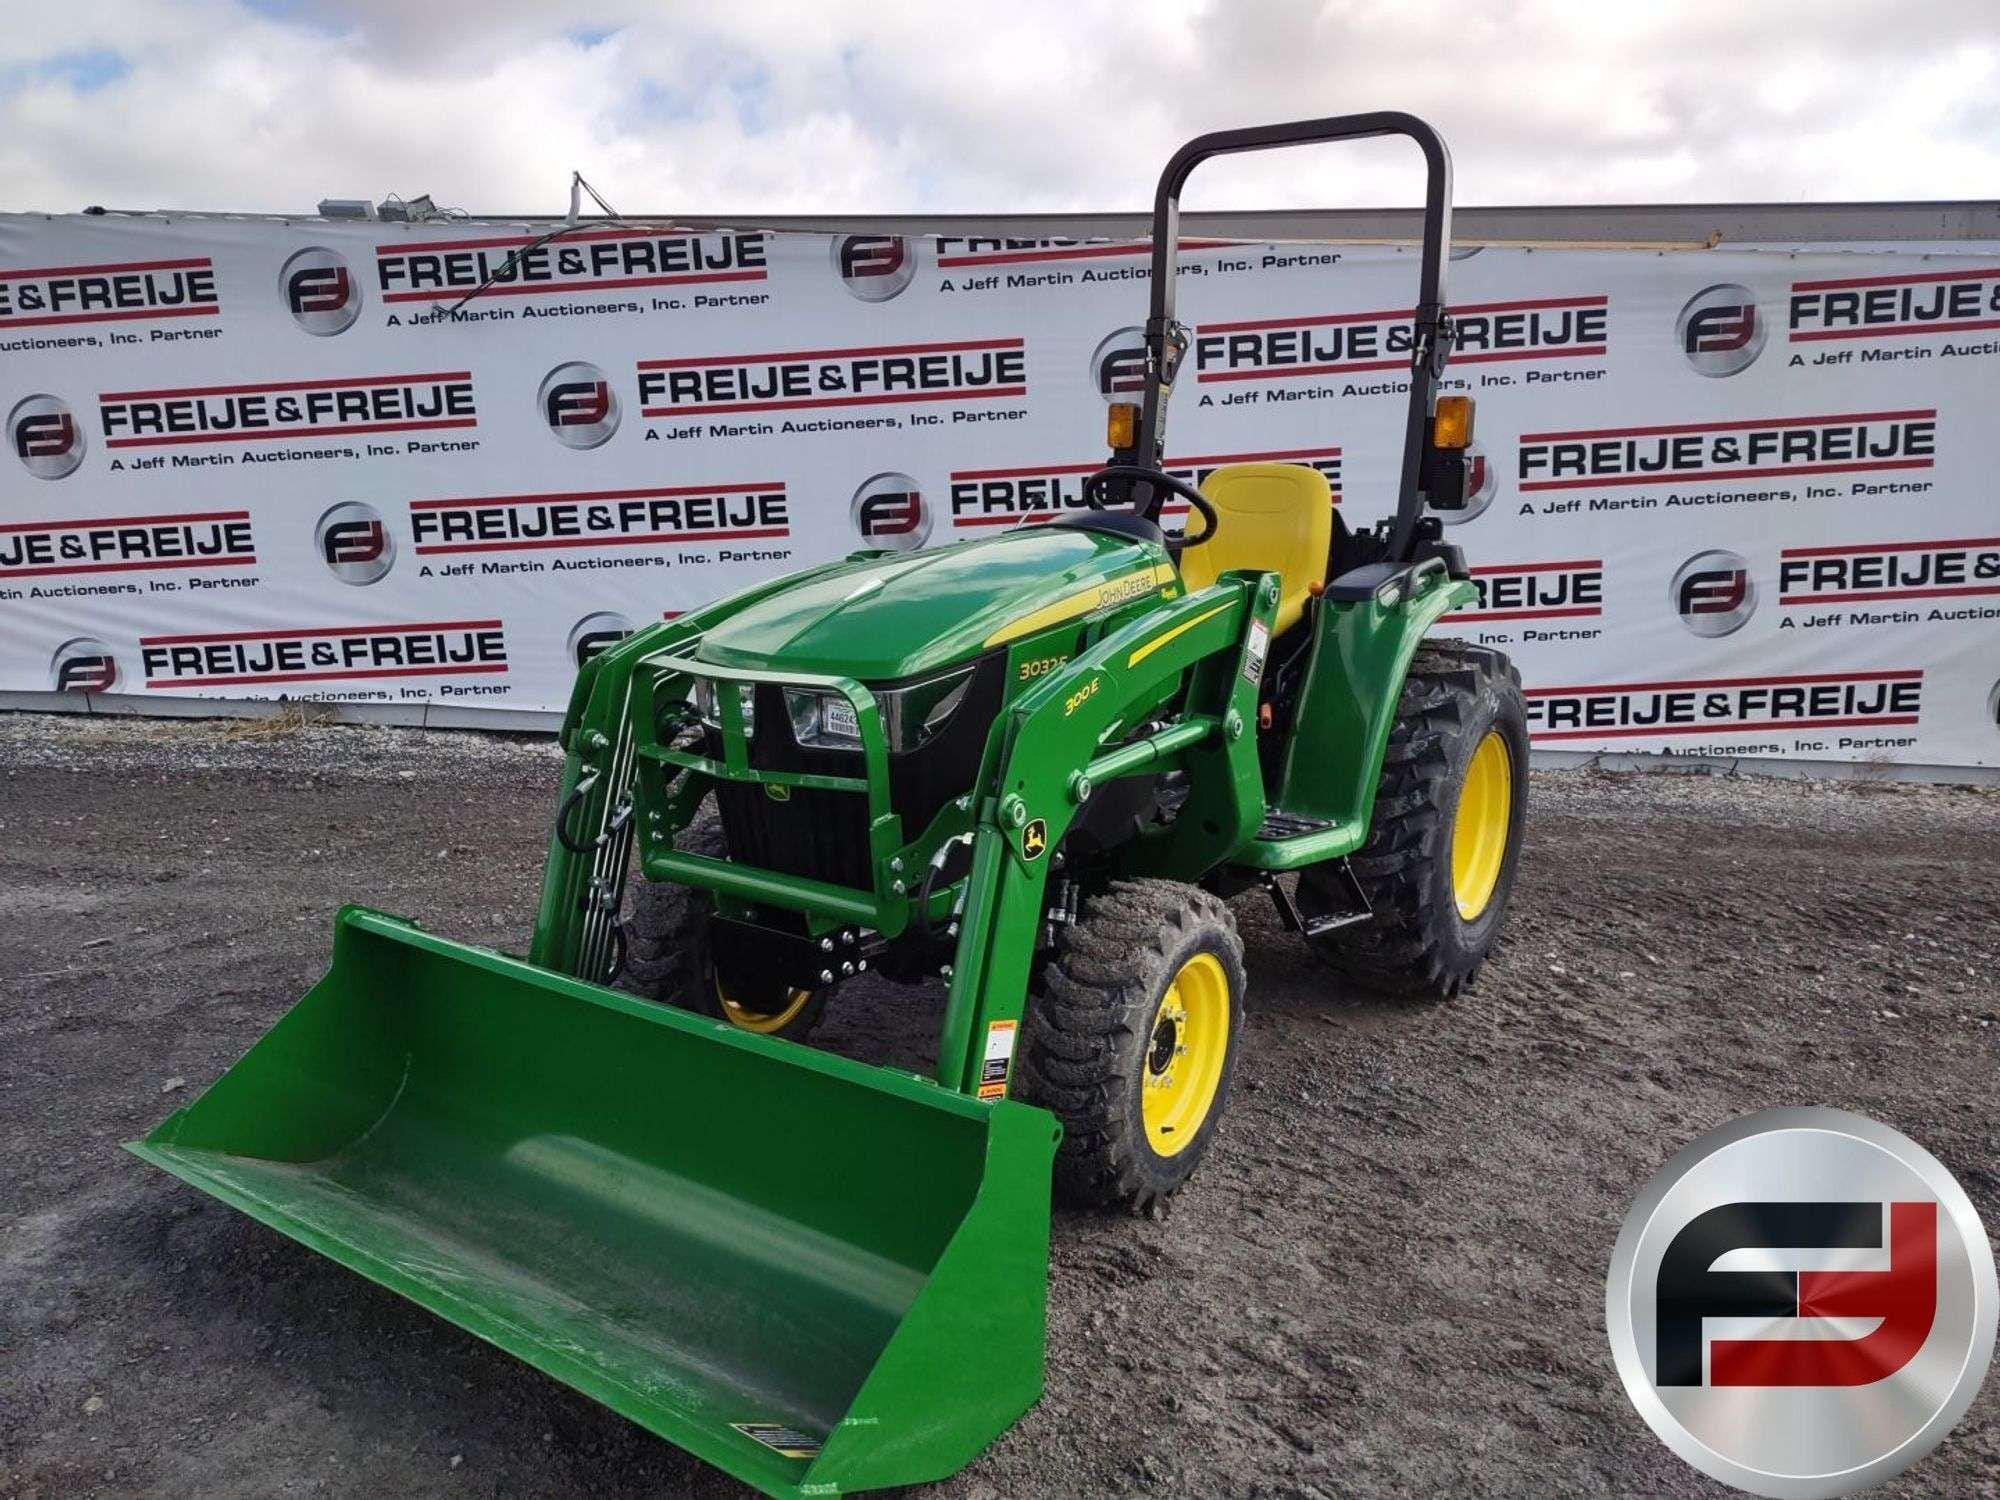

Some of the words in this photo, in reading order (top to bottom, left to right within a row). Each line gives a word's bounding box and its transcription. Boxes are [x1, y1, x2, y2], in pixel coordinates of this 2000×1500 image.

[940, 281, 955, 293] A
[962, 277, 999, 291] Jeff
[1007, 272, 1073, 288] Martin
[1218, 260, 1252, 272] Inc.
[1262, 254, 1341, 268] Partner
[387, 315, 401, 328] A
[451, 307, 514, 323] Martin
[522, 303, 644, 318] Auctioneers,
[652, 299, 686, 311] Inc.
[695, 293, 770, 308] Partner
[0, 338, 103, 352] uctioneers,
[110, 333, 142, 344] Inc.
[151, 328, 223, 342] Partner
[1455, 309, 1608, 351] REIJE
[1789, 355, 1805, 367] A
[1813, 351, 1853, 365] Jeff
[1861, 346, 1931, 362] Martin
[1940, 341, 2000, 357] Aucti
[1199, 395, 1213, 406] A
[1221, 391, 1259, 405] Jeff
[1267, 387, 1333, 402] Martin
[1482, 375, 1516, 386] Inc.
[1527, 369, 1607, 383] Partner
[645, 429, 659, 441] A
[667, 427, 702, 439] Jeff
[710, 423, 773, 437] Martin
[781, 418, 902, 433] Auctioneers,
[911, 414, 944, 425] Inc.
[953, 410, 1027, 423] Partner
[111, 460, 124, 470] A
[131, 457, 165, 469] Jeff
[172, 453, 234, 467] Martin
[242, 449, 359, 463] Auctioneers,
[367, 445, 399, 456] Inc.
[408, 442, 480, 453] Partner
[1519, 503, 1534, 515] A
[1543, 500, 1581, 513] Jeff
[1589, 497, 1657, 511] Martin
[1666, 491, 1796, 506] Auctioneers,
[1807, 487, 1842, 498] Inc.
[1852, 483, 1932, 495] Partner
[420, 566, 433, 577] A
[440, 564, 474, 576] Jeff
[482, 561, 544, 574] Martin
[552, 557, 670, 570] Auctioneers,
[679, 553, 710, 564] Inc.
[719, 551, 791, 562] Partner
[30, 585, 143, 599] Auctioneers,
[150, 581, 181, 591] Inc.
[189, 577, 260, 590] Partner
[1455, 572, 1603, 611] REIJE
[1780, 617, 1795, 628] A
[1803, 614, 1841, 627] Jeff
[1850, 611, 1919, 624] Martin
[1480, 633, 1513, 644] Inc.
[1524, 630, 1602, 642] Partner
[401, 688, 432, 698] Inc.
[441, 684, 511, 696] Partner
[1795, 740, 1829, 752] Inc.
[1839, 738, 1918, 751] Partner
